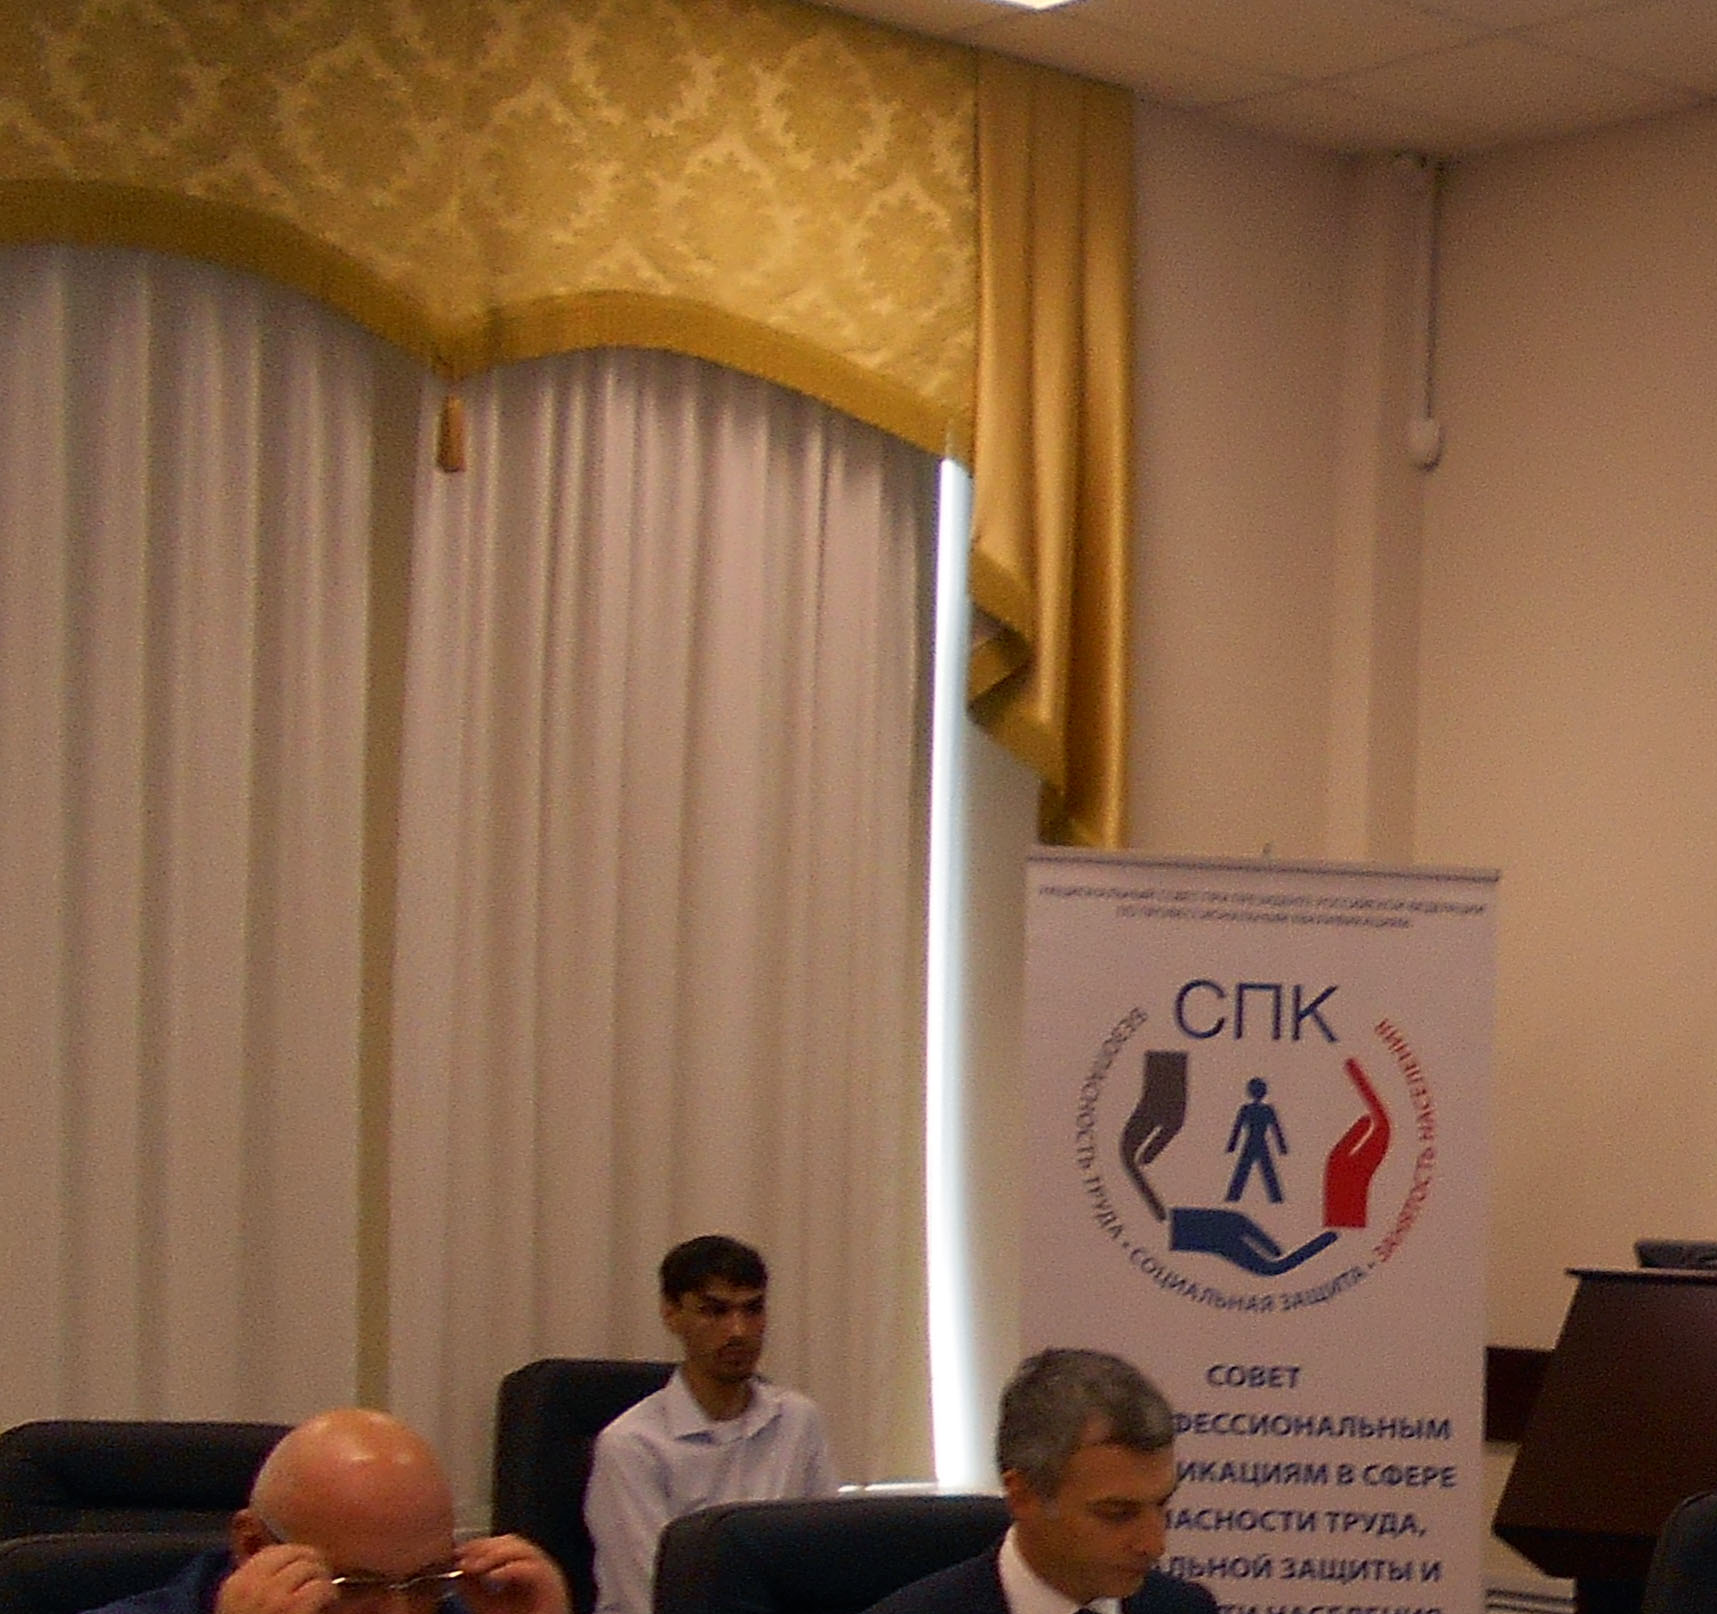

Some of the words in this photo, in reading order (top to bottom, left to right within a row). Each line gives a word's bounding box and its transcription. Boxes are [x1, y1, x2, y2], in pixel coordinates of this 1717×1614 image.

[1173, 978, 1340, 1045] СПК
[1128, 1248, 1275, 1314] СОЦИАЛЬНАЯ
[1206, 1364, 1301, 1389] СОВЕТ
[1172, 1411, 1452, 1440] ФЕССИОНАЛЬНЫМ
[1176, 1460, 1328, 1488] ИКАЦИЯМ
[1336, 1463, 1354, 1486] В
[1361, 1463, 1457, 1489] СФЕРЕ
[1165, 1508, 1317, 1533] АСНОСТИ
[1325, 1510, 1427, 1538] ТРУДА,
[1280, 1557, 1412, 1585] ЗАЩИТЫ
[1420, 1560, 1442, 1583] И
